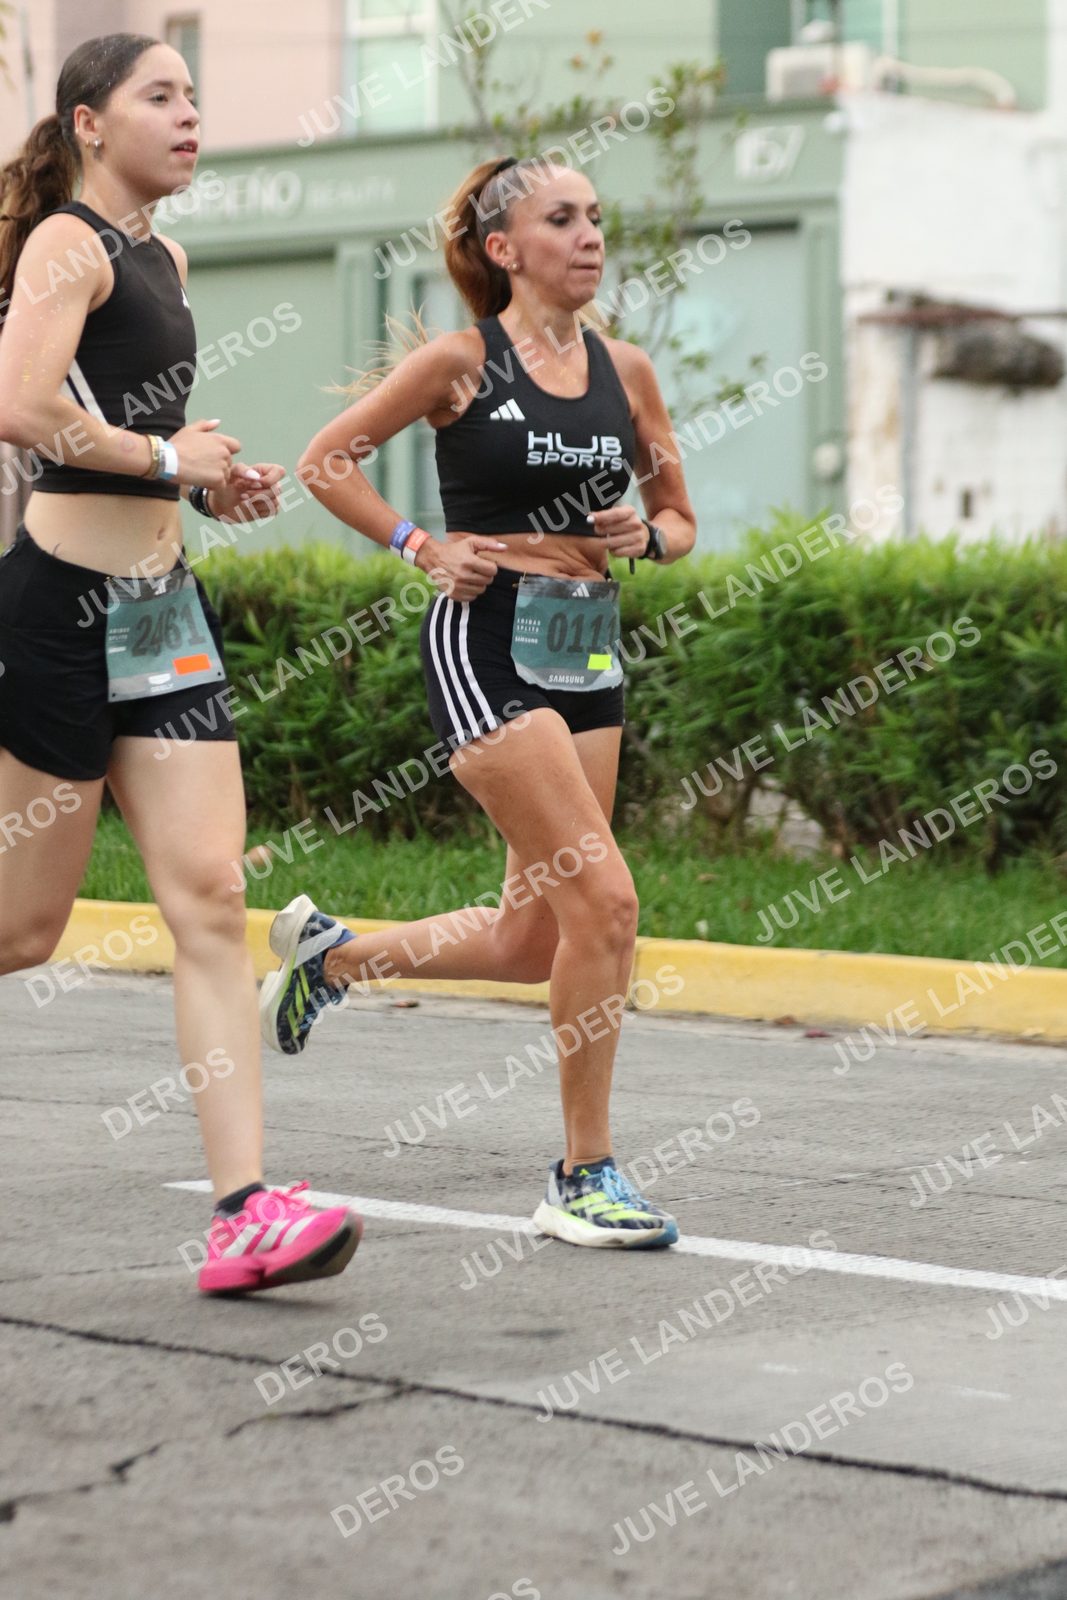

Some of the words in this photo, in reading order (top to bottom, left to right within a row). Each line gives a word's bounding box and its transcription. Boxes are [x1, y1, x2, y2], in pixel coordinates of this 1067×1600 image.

[528, 431, 622, 456] HUB
[527, 451, 622, 471] SPORTS
[548, 674, 585, 684] SAMSUNG
